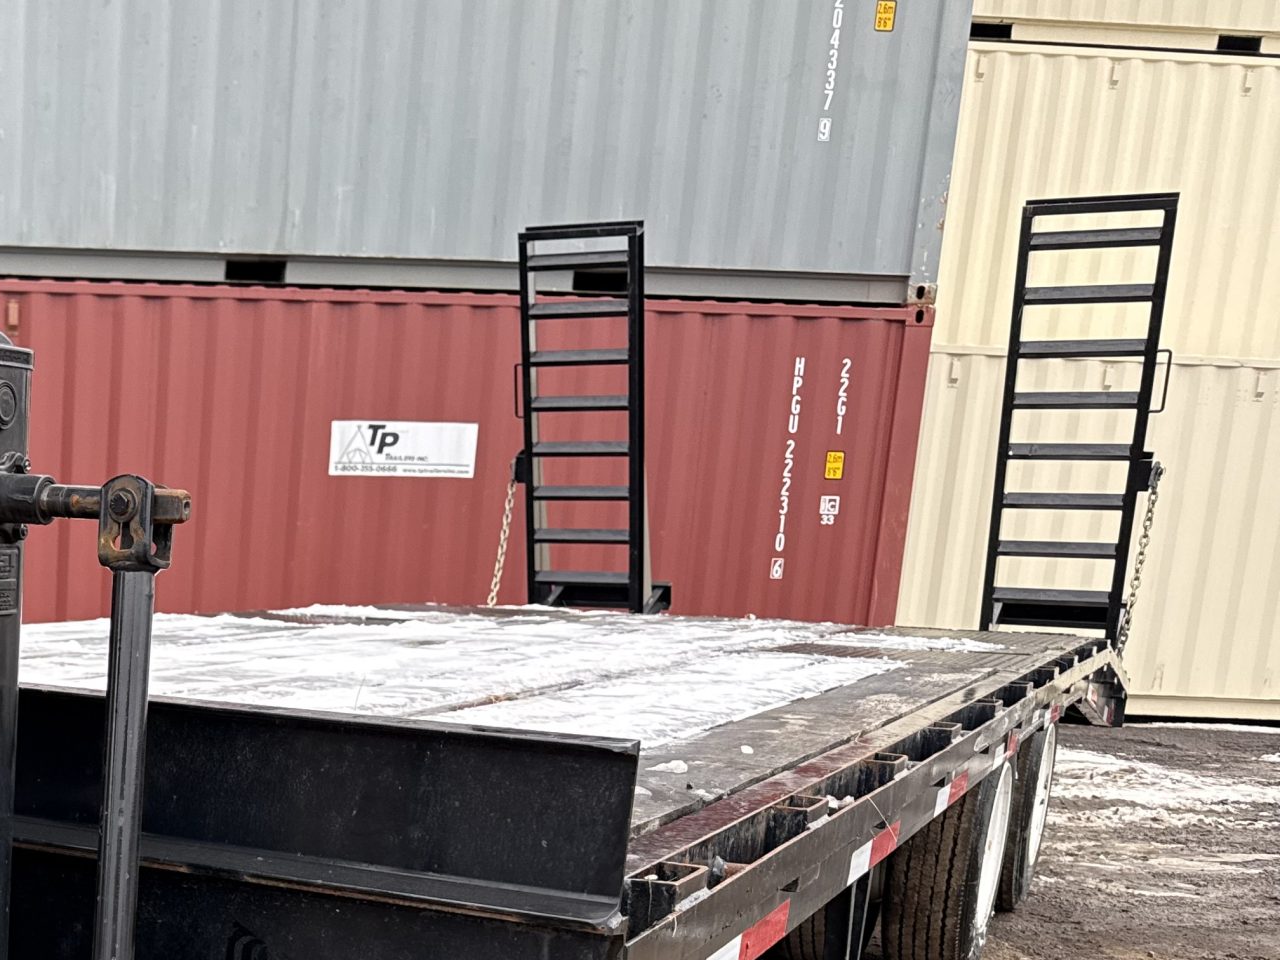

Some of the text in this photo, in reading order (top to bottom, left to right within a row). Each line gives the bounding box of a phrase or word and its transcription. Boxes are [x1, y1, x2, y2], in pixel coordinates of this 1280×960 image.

[819, 118, 831, 141] 9
[836, 358, 851, 435] 22G1
[368, 424, 400, 454] TP
[771, 357, 805, 579] HPGU 222310 6
[820, 514, 835, 525] 33
